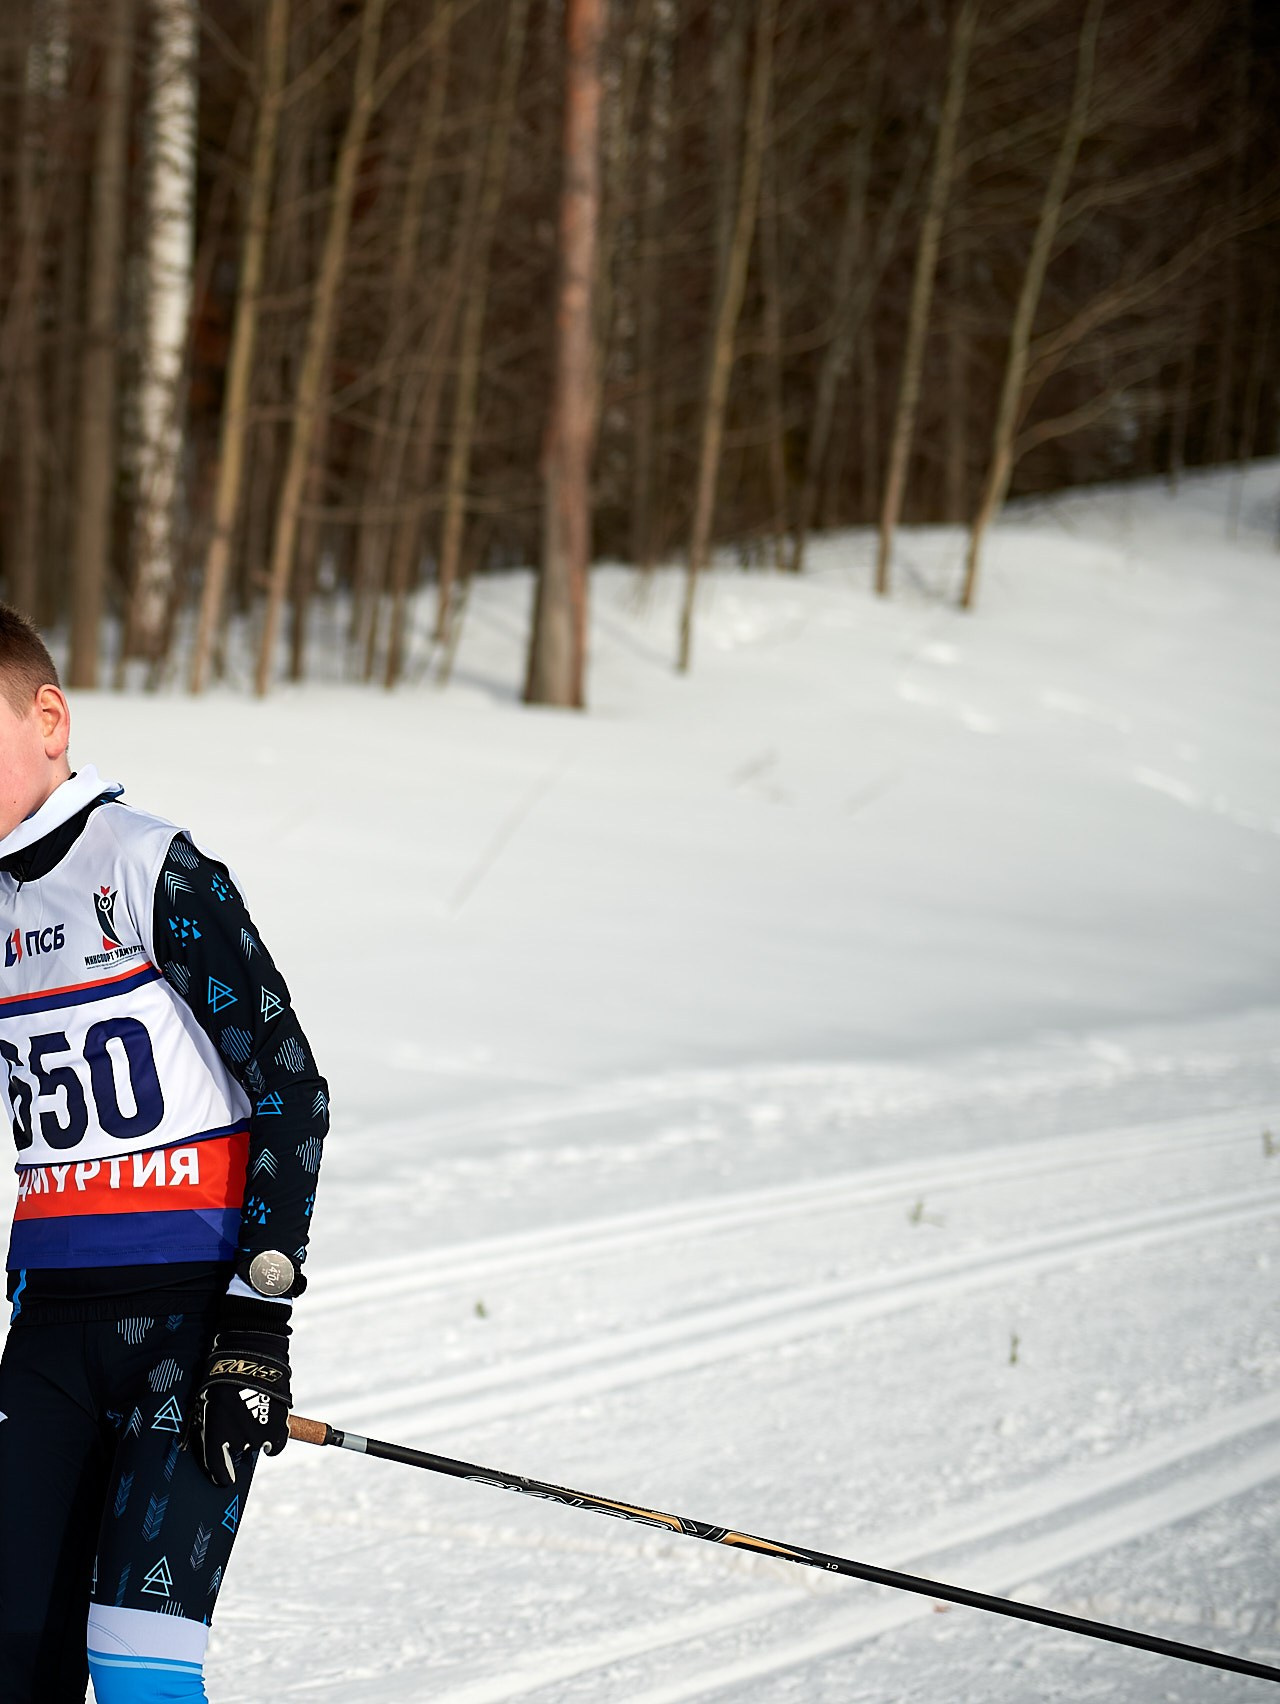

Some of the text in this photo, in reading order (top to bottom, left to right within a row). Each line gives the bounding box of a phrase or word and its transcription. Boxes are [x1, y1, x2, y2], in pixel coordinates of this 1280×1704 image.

[25, 923, 65, 957] ПСБ
[18, 1147, 200, 1201] ДМУРТИЯ
[265, 1262, 280, 1287] 14:04
